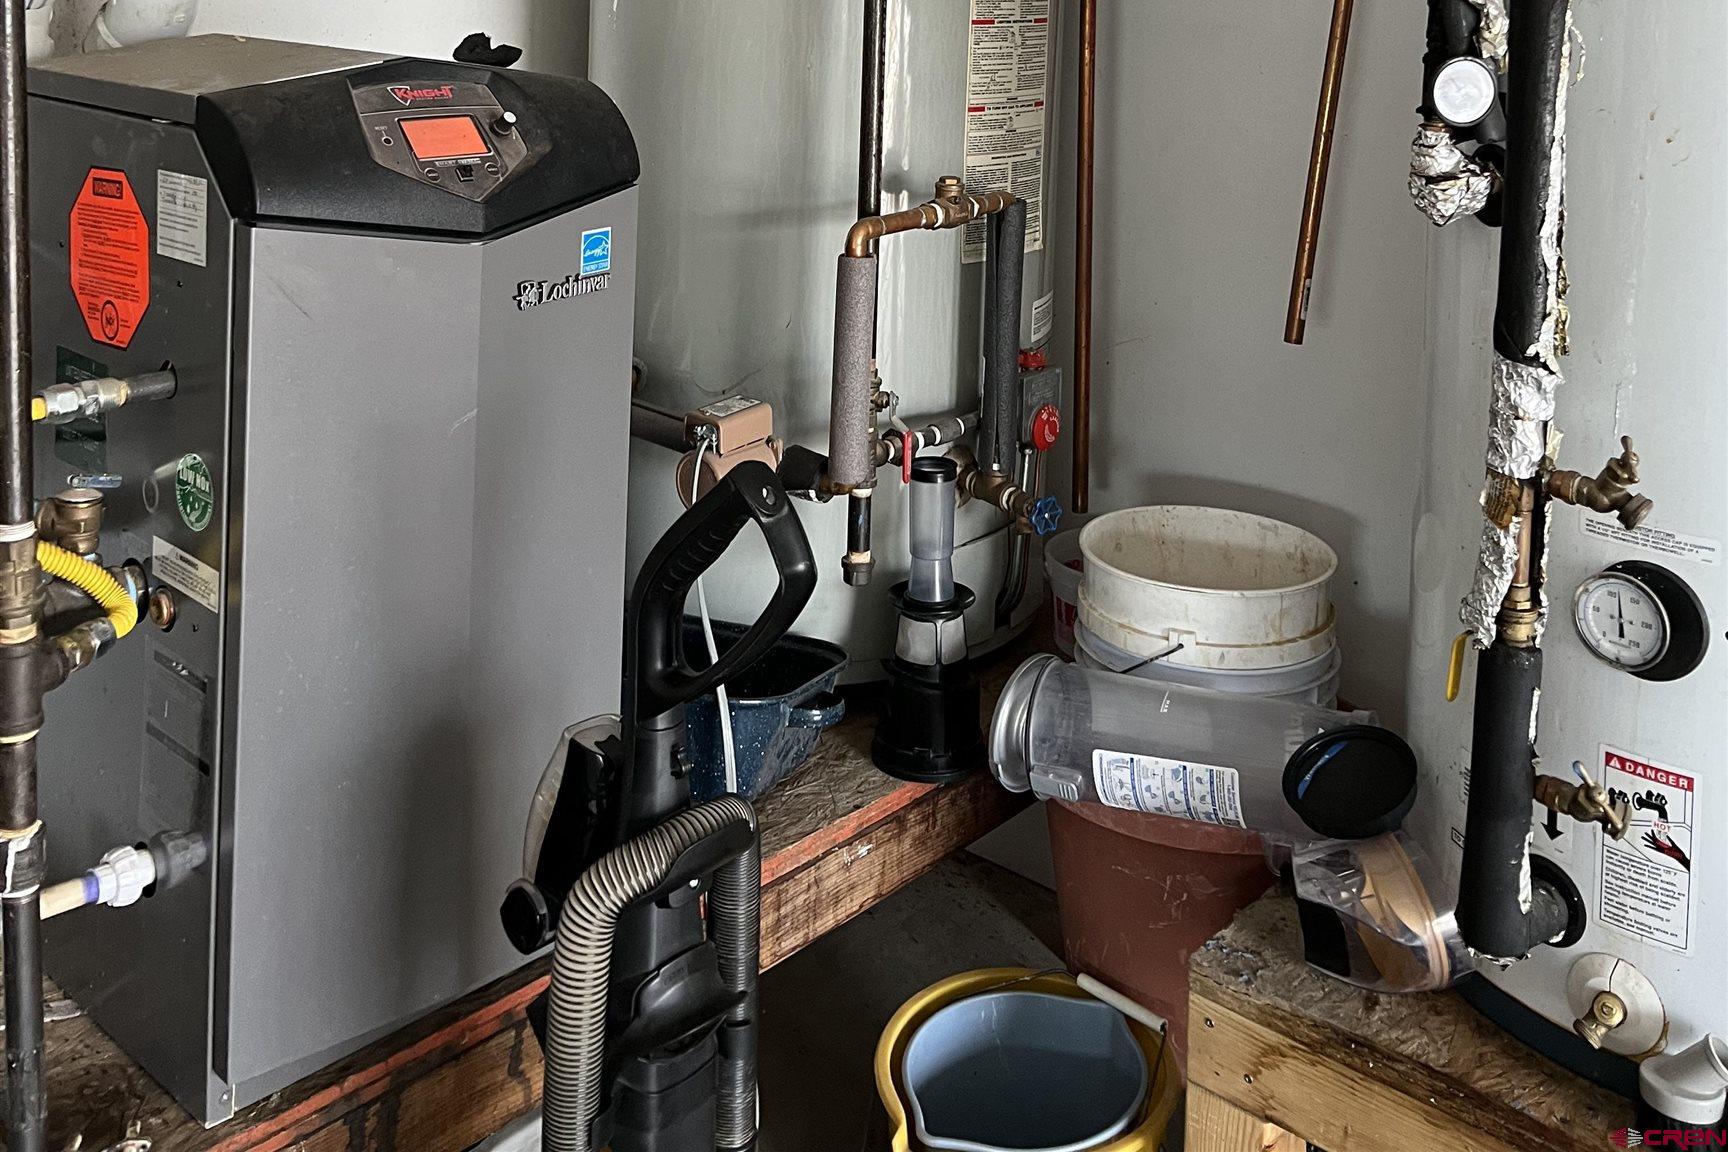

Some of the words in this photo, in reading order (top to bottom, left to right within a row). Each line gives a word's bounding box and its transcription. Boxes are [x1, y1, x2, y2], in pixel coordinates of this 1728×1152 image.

[394, 85, 454, 100] KNIGHT
[540, 273, 611, 304] Lochinvar
[1607, 590, 1617, 598] 100
[1630, 597, 1640, 605] 150
[1641, 621, 1653, 630] 200
[1628, 640, 1640, 648] 250
[1625, 762, 1688, 789] DANGER
[1654, 822, 1671, 832] HOT
[1606, 849, 1619, 857] Water
[1620, 854, 1649, 868] temperature
[1615, 858, 1629, 866] cause
[1631, 864, 1646, 872] severe
[1606, 866, 1626, 878] Children,
[1628, 875, 1648, 885] disabled
[1660, 887, 1676, 895] elderly
[1611, 874, 1628, 884] highest
[1645, 887, 1659, 895] being
[1605, 885, 1621, 894] setting
[1622, 892, 1650, 904] temperature
[1615, 883, 1640, 895] instruction
[1641, 893, 1659, 902] manual
[1604, 908, 1633, 922] Temperature
[1653, 927, 1668, 935] valves
[1629, 905, 1644, 914] before
[1646, 911, 1664, 921] bathing
